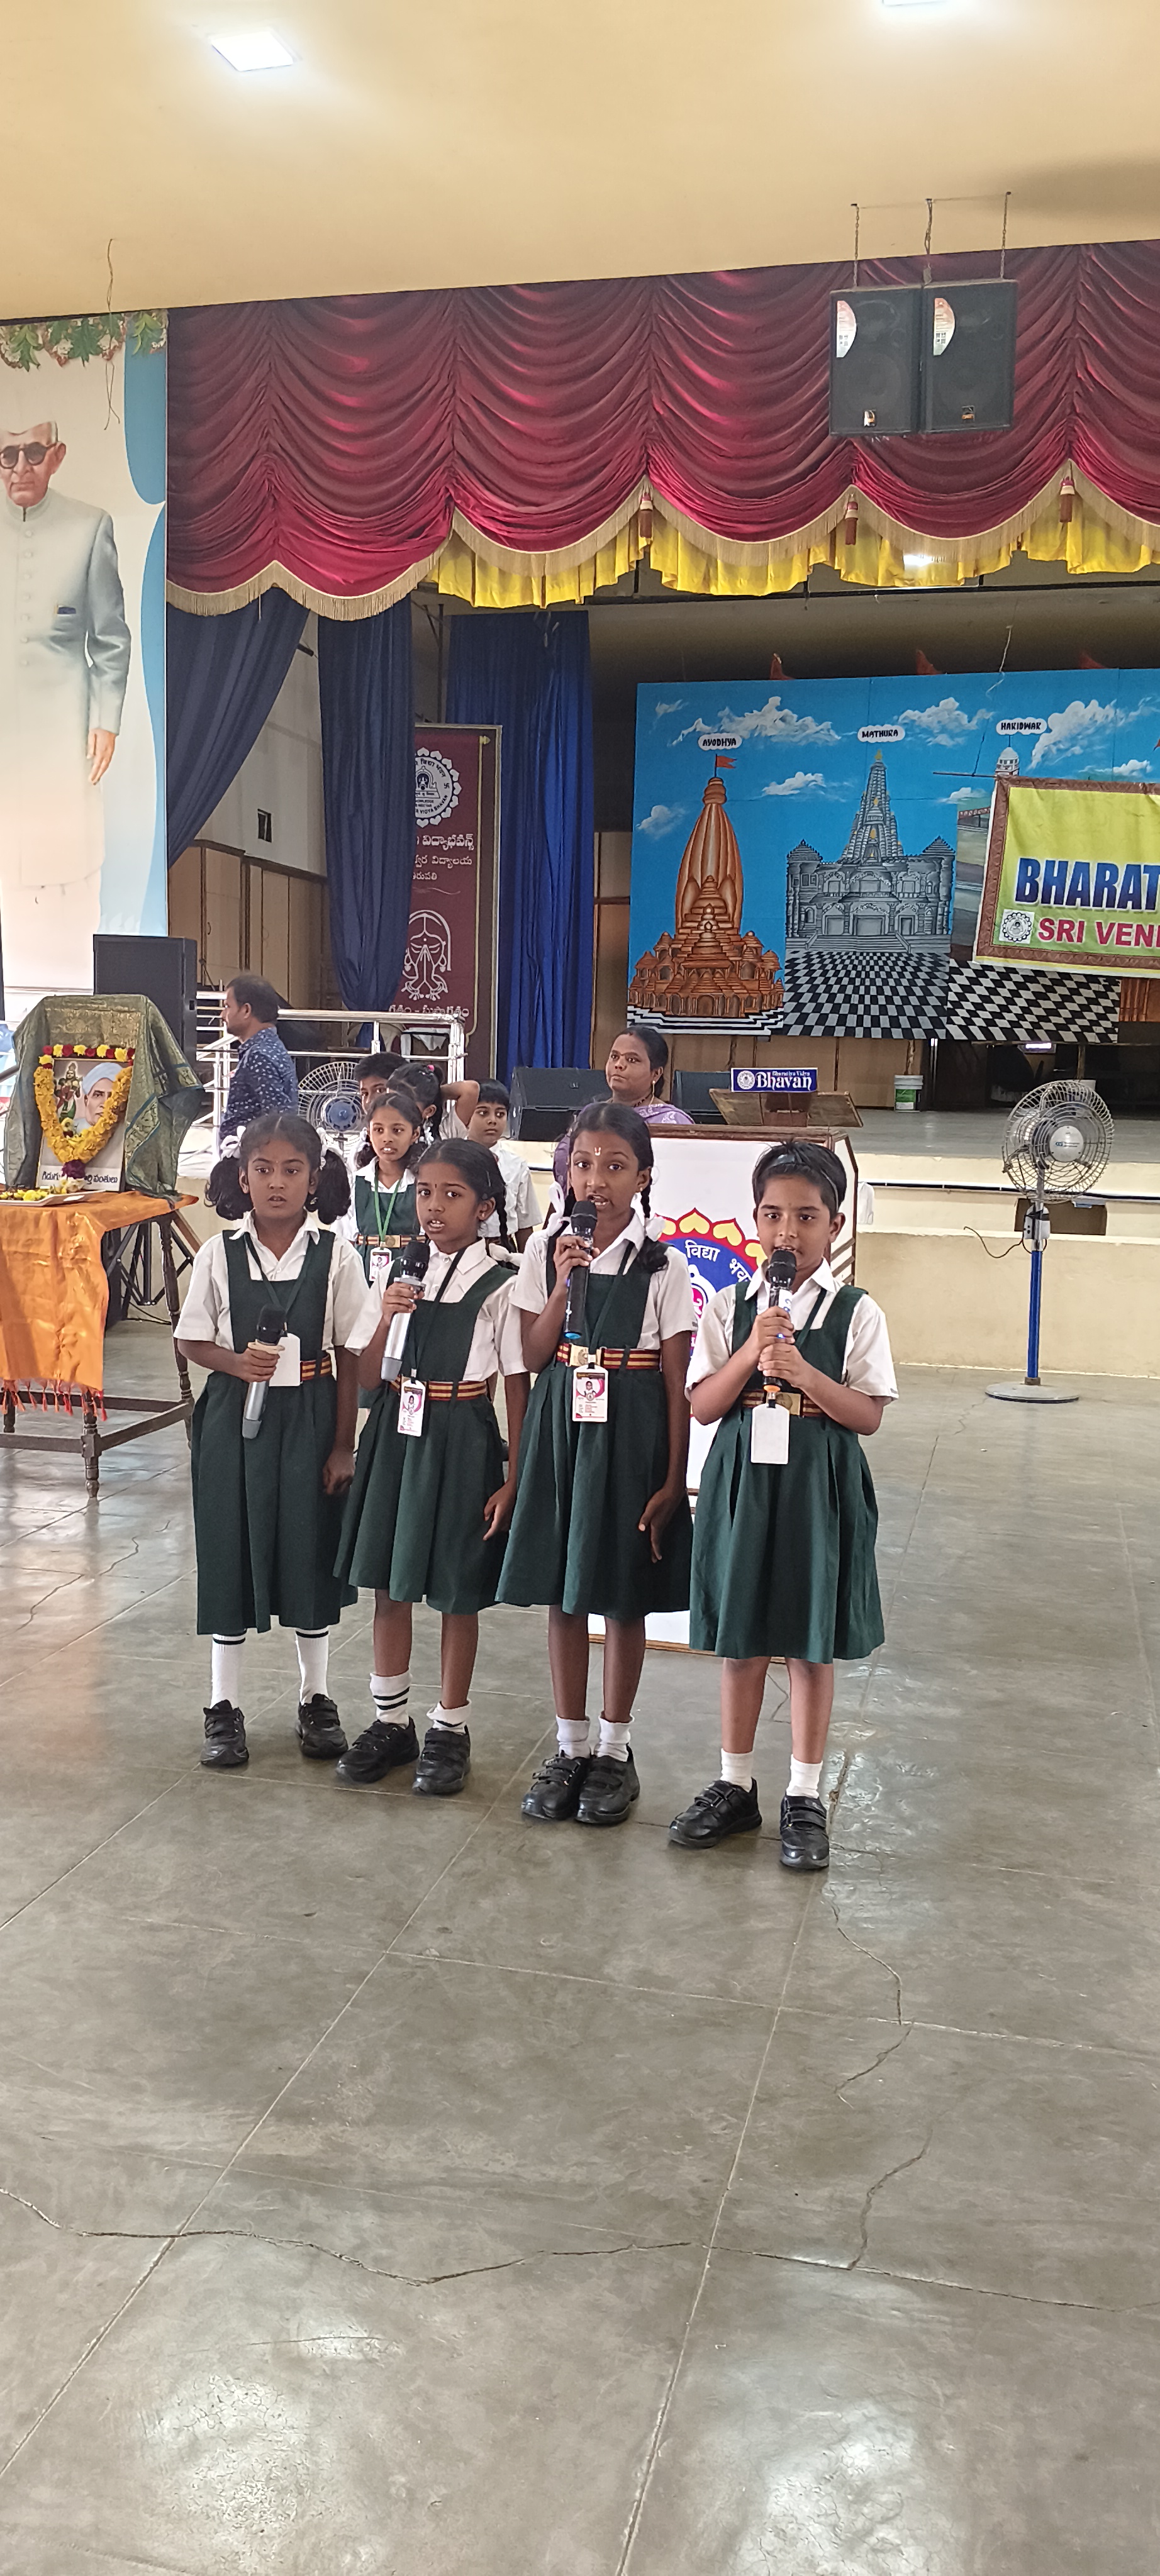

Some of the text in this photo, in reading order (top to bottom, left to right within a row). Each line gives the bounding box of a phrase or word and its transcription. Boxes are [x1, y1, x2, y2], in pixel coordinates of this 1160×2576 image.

[862, 729, 898, 738] MATHURA
[702, 738, 737, 747] AYODHYA
[432, 855, 472, 869] విద్యాలయ
[1038, 918, 1086, 943] SRI
[755, 1071, 812, 1091] Bhavan
[93, 1174, 118, 1183] పంతులు
[684, 1239, 753, 1283] विद्या भव
